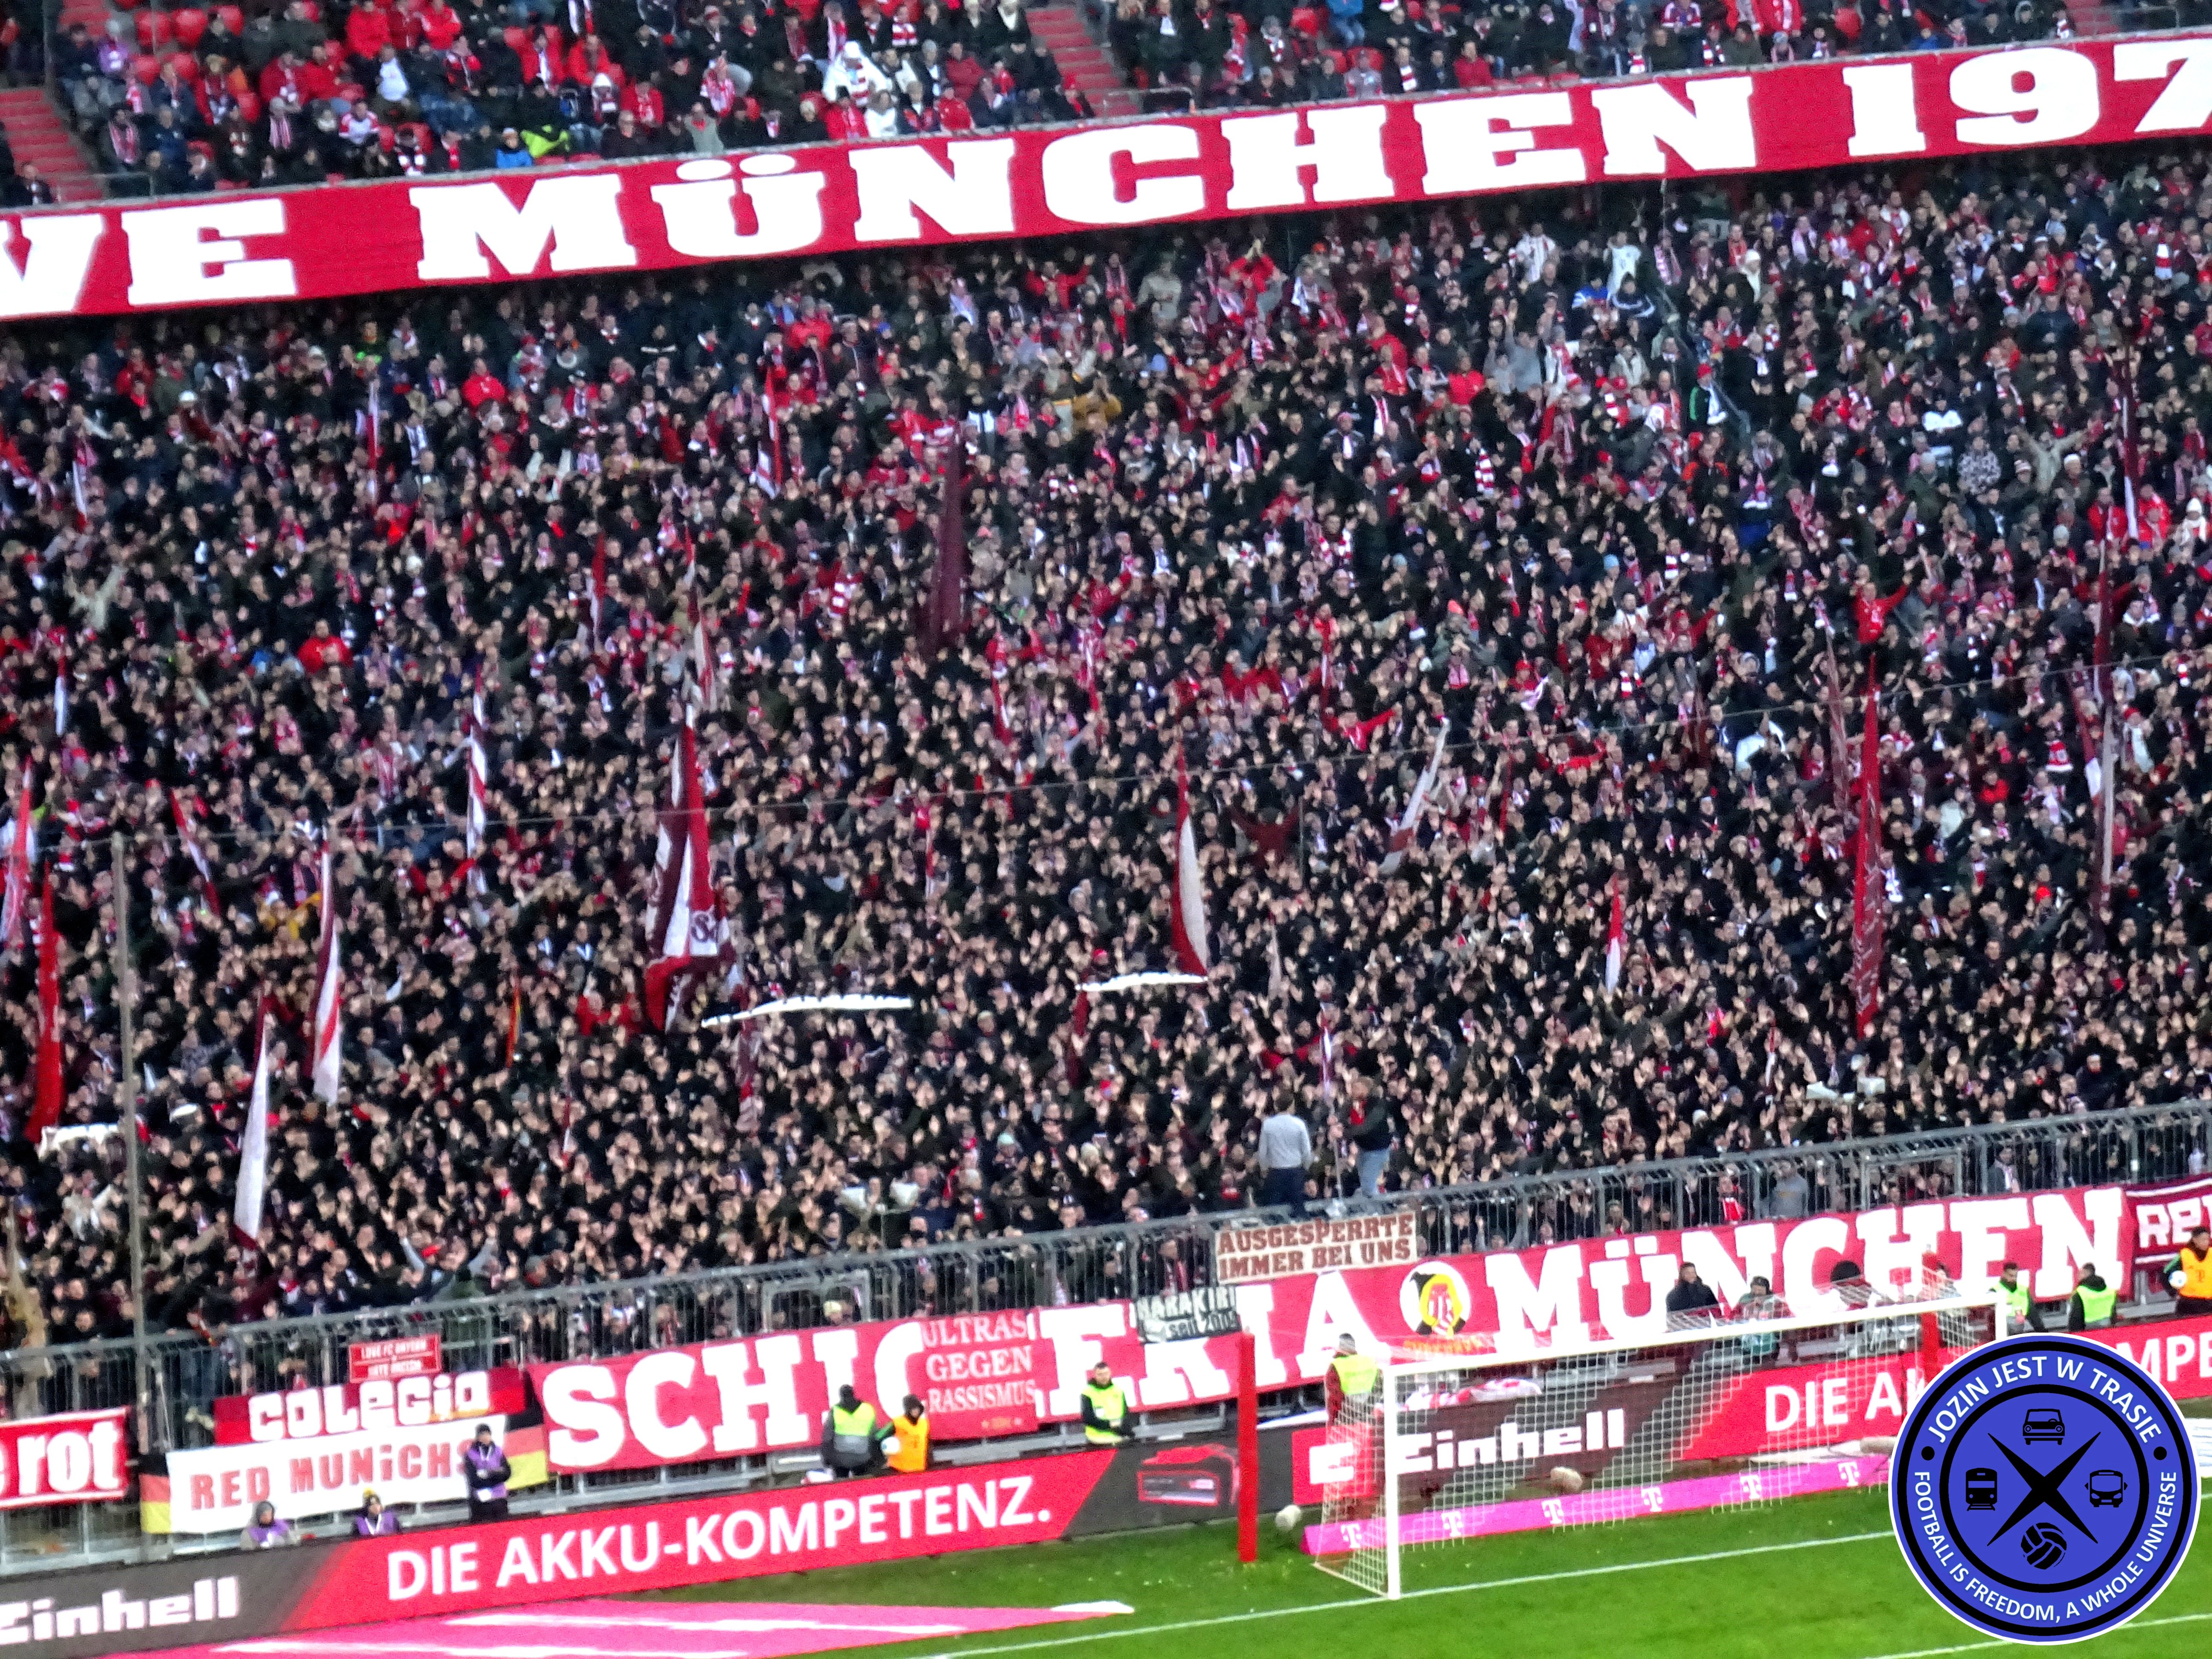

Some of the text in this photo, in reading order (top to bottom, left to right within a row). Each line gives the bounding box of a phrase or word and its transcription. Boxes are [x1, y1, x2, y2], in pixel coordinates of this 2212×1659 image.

[410, 76, 1755, 280] MÜNCHEN
[1218, 1213, 1413, 1256] AUSGESPERRTE
[1219, 1239, 1410, 1280] IMMER BEI UNS
[1485, 1187, 2122, 1353] MÜNCHEN
[920, 1311, 1028, 1348] ULTRAS
[926, 1345, 1032, 1382] GEGEN
[928, 1379, 1036, 1413] RASSISMUS
[1765, 1377, 1848, 1432] DIE
[17, 1421, 119, 1493] rot
[1396, 1408, 1624, 1474] Einhell
[189, 1466, 271, 1511] RED
[387, 1476, 1051, 1601] DIE AKKU-KOMPETENZ.
